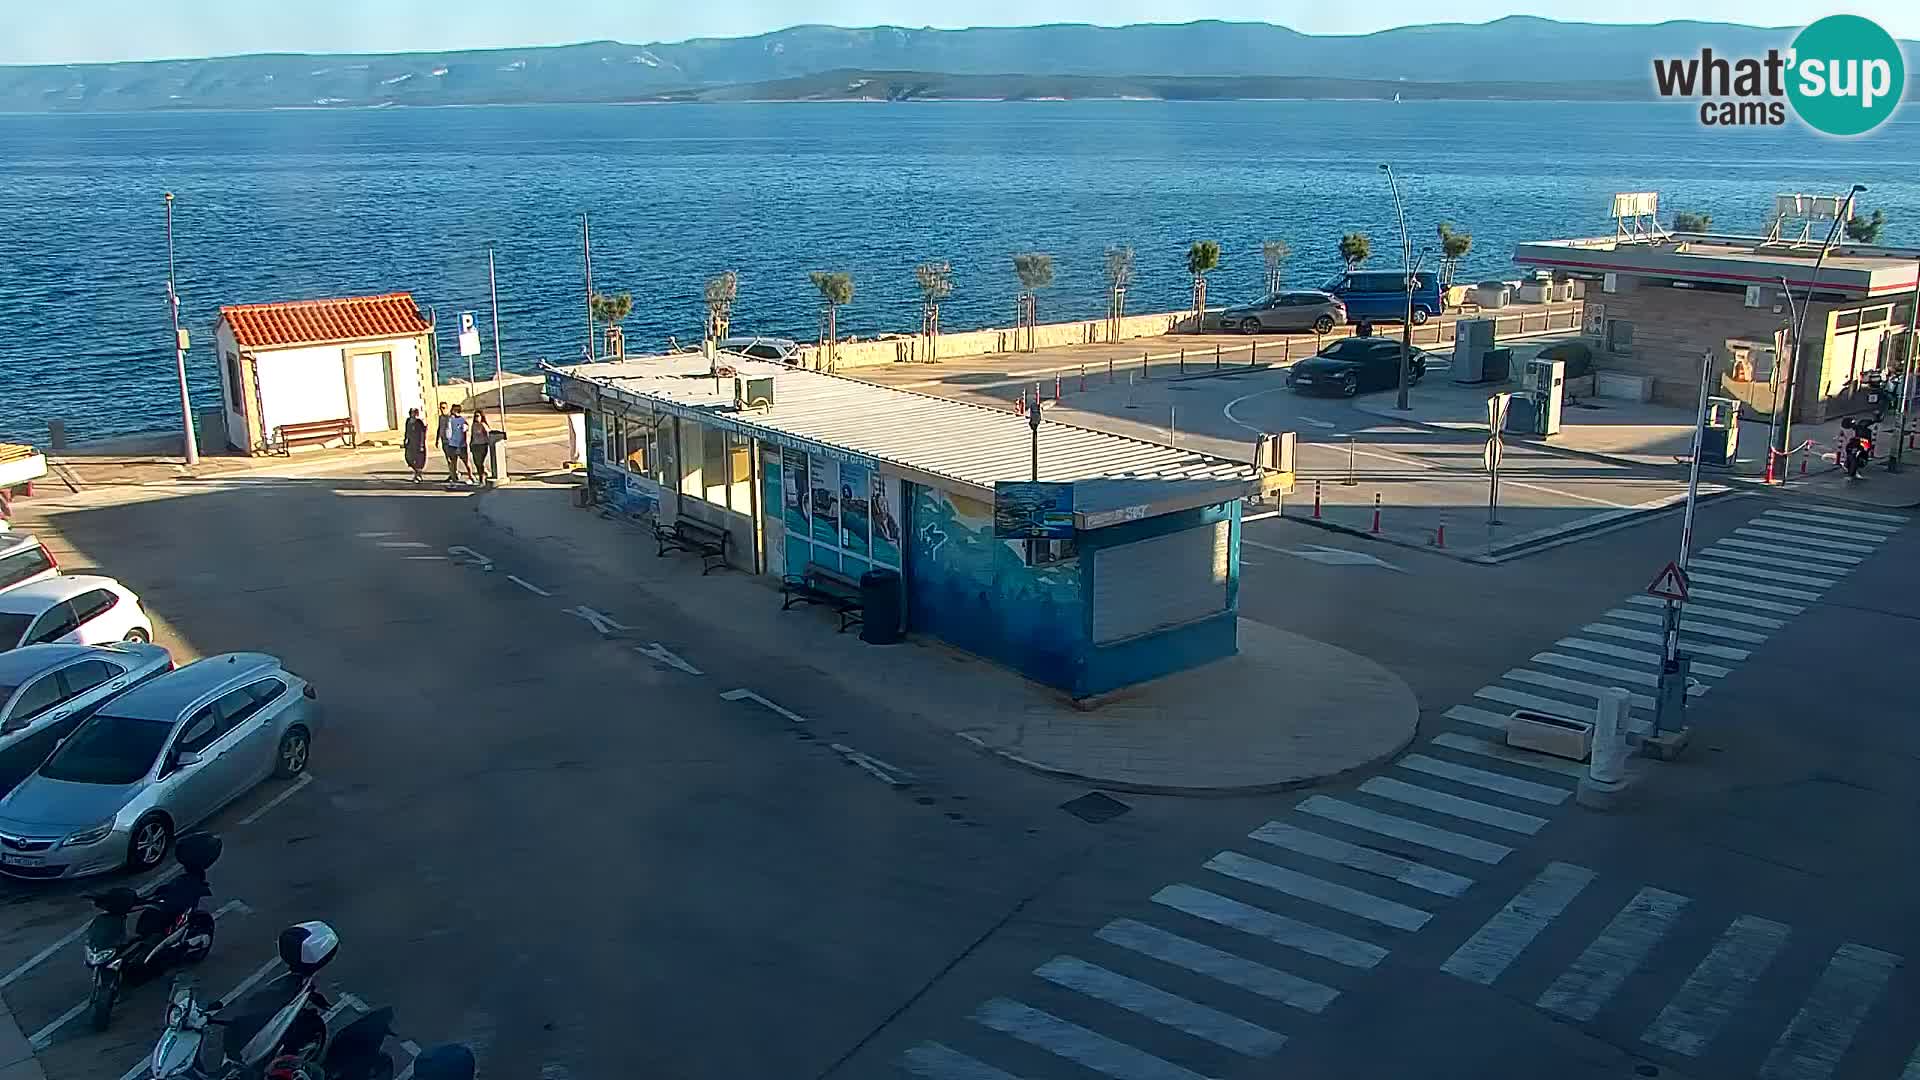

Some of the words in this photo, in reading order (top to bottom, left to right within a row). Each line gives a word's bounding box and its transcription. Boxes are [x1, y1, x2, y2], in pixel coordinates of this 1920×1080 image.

[462, 314, 473, 332] P
[793, 439, 822, 454] STATION
[825, 448, 849, 461] TICKET
[850, 454, 876, 469] OFFICE
